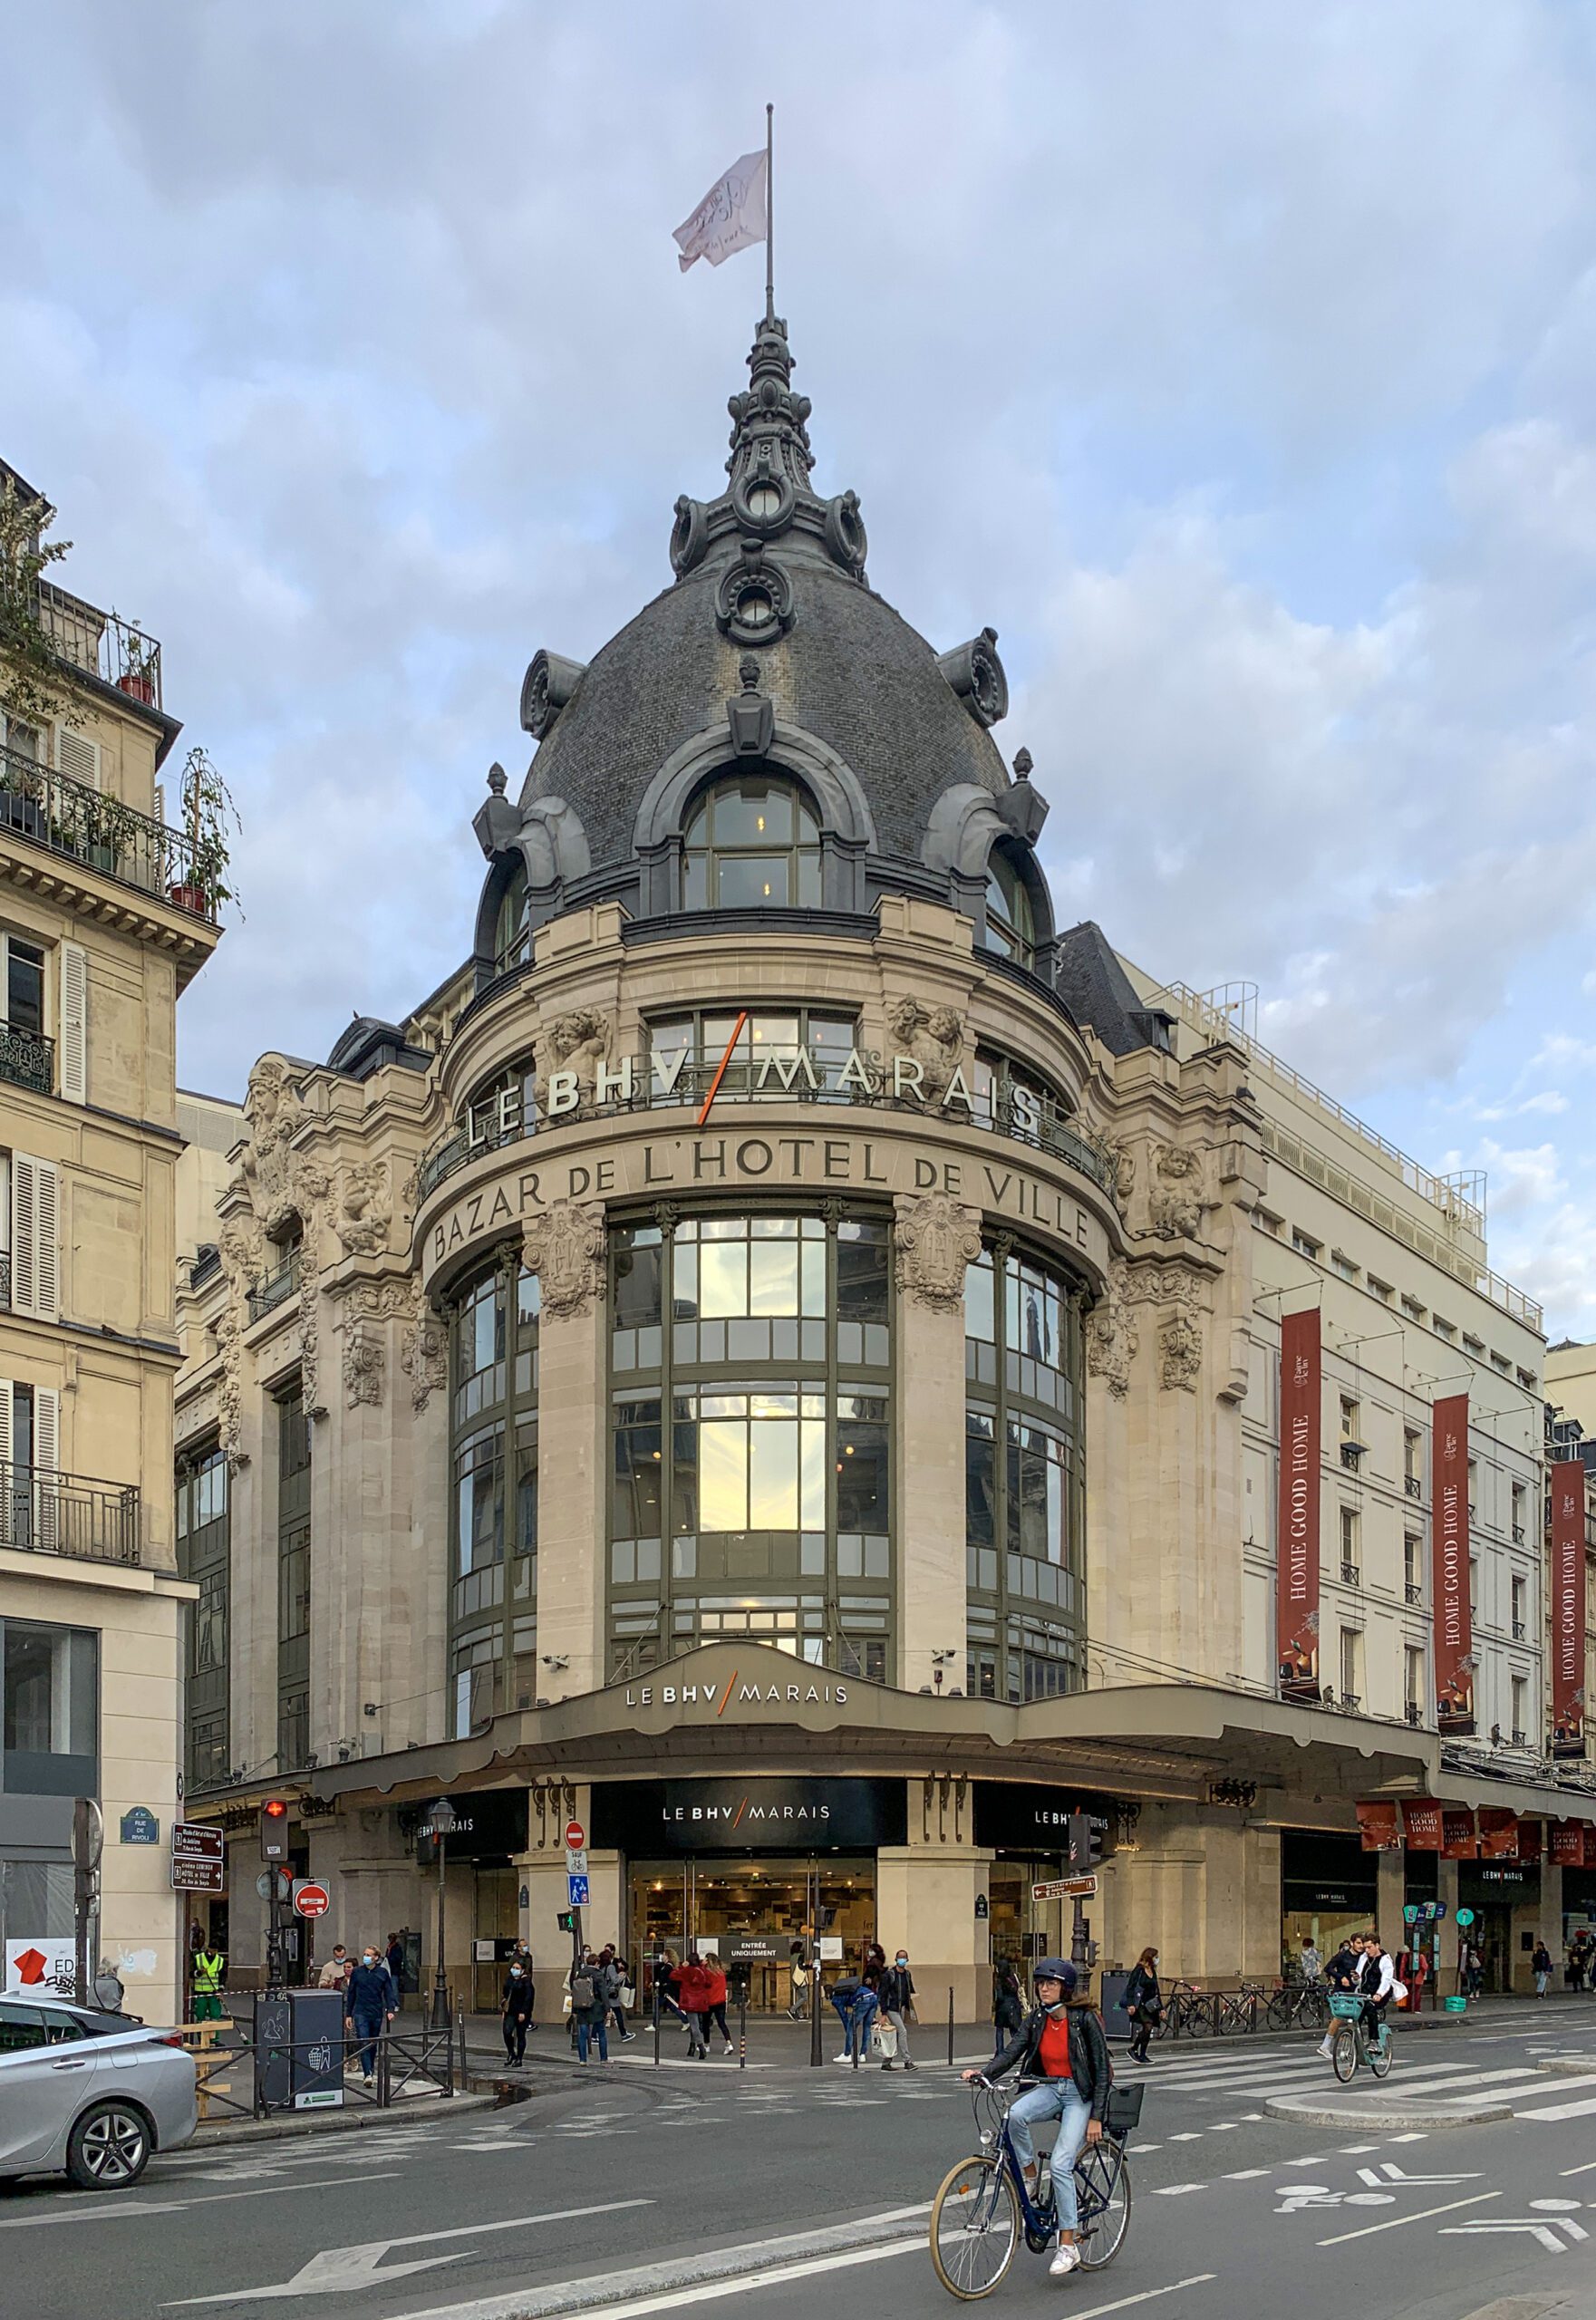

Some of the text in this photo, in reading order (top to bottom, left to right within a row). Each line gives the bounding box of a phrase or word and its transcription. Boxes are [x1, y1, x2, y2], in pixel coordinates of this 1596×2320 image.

[468, 1085, 520, 1147] LE
[434, 1173, 546, 1262] BAZAR
[568, 1160, 614, 1198] DE
[644, 1139, 887, 1184] L'HOTEL
[914, 1158, 961, 1194] DE
[983, 1165, 1088, 1248] VILLE
[1291, 1415, 1309, 1600] HOME GOOD HOME
[1443, 1484, 1460, 1646] HOME GOOD HOME
[1562, 1540, 1576, 1681] HOME GOOD HOME
[626, 1688, 653, 1706] LE
[663, 1807, 684, 1820] LE
[1035, 1811, 1049, 1823] LE
